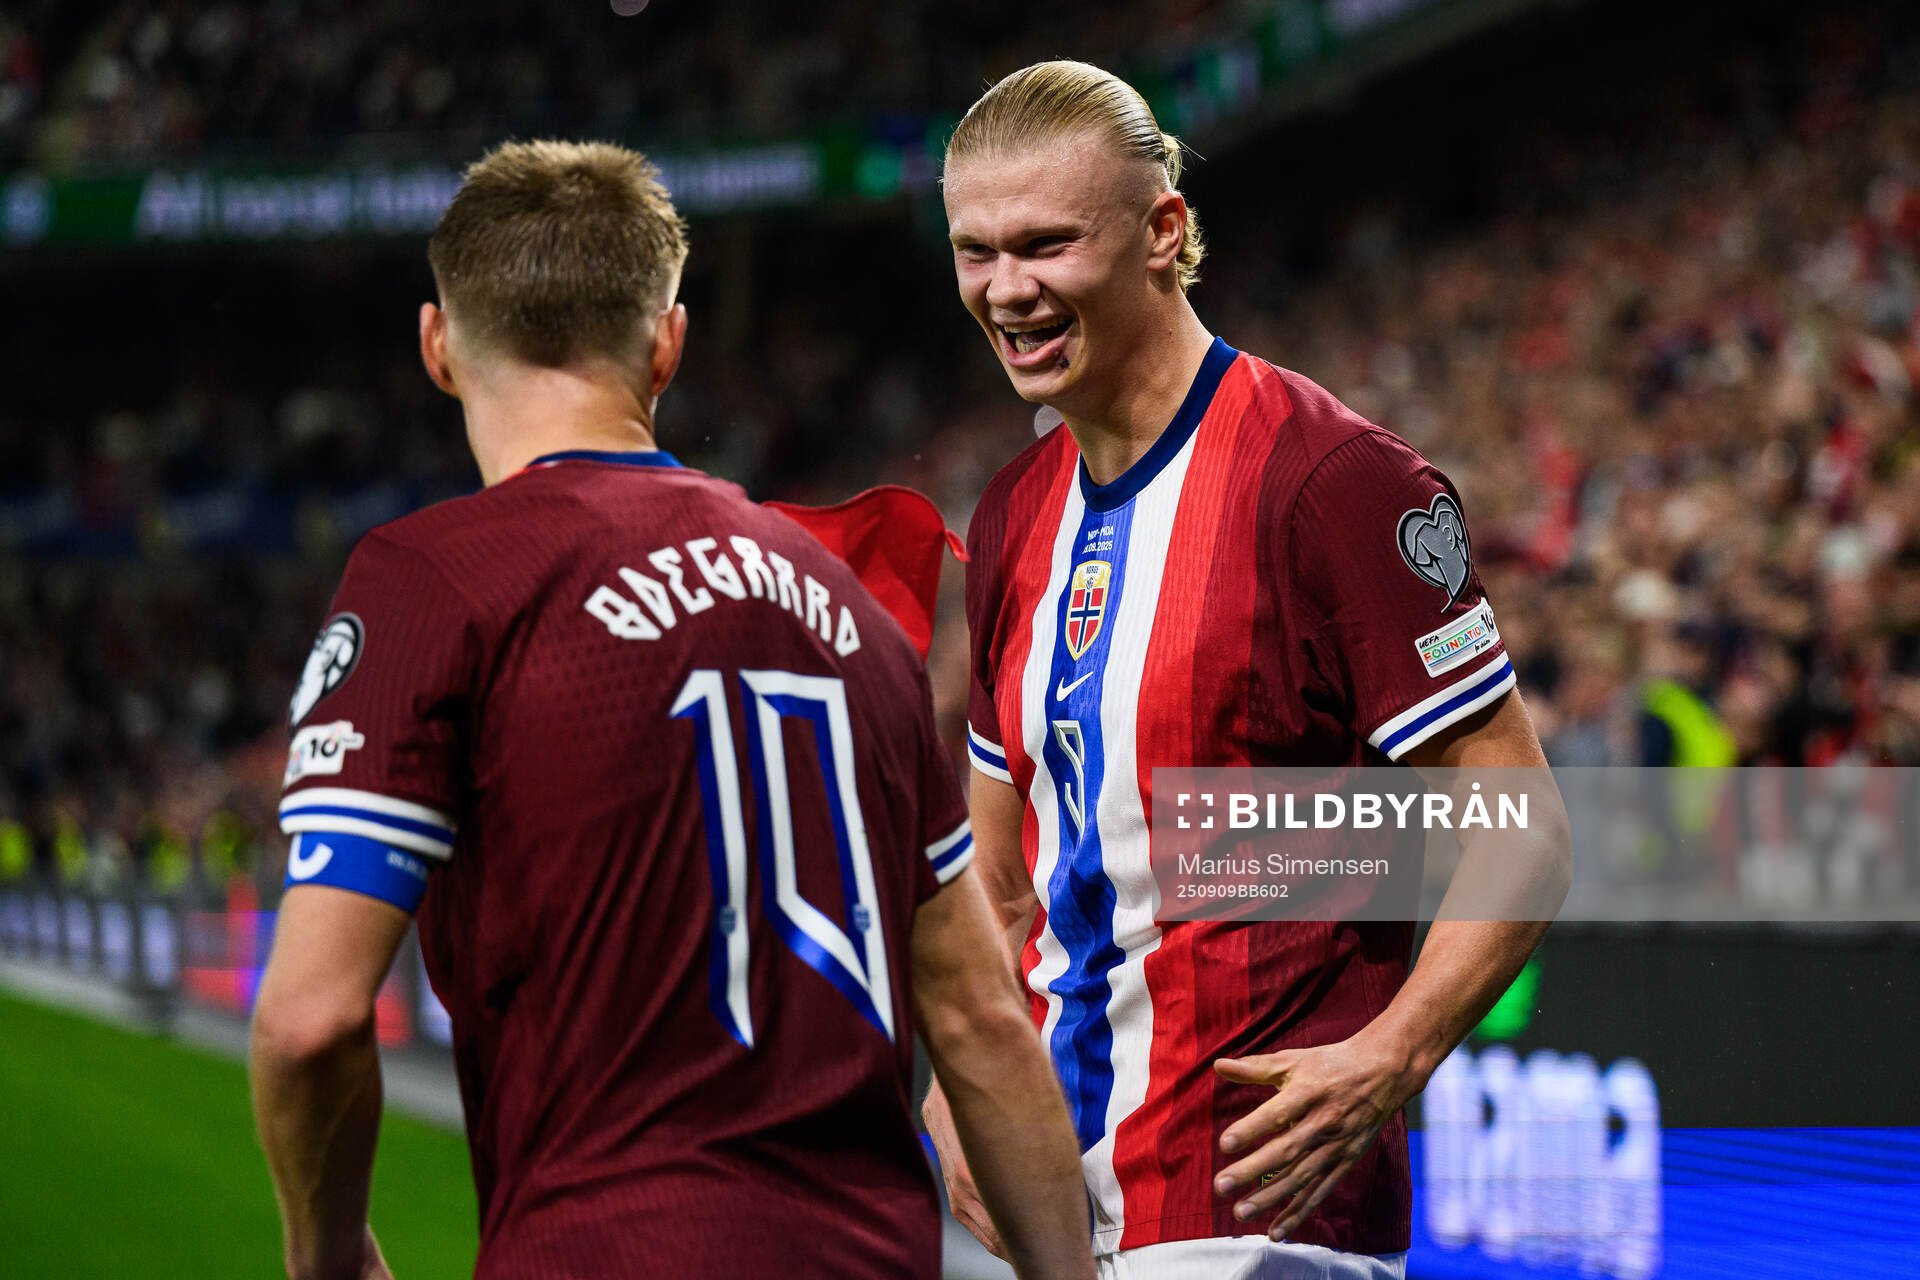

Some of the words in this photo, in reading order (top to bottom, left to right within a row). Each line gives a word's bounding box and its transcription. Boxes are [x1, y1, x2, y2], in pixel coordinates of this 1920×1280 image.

[1419, 635, 1439, 649] UEFA
[1423, 625, 1486, 662] FOUNDATION
[310, 738, 338, 758] 10
[1052, 720, 1086, 847] 9
[669, 669, 895, 1050] 10
